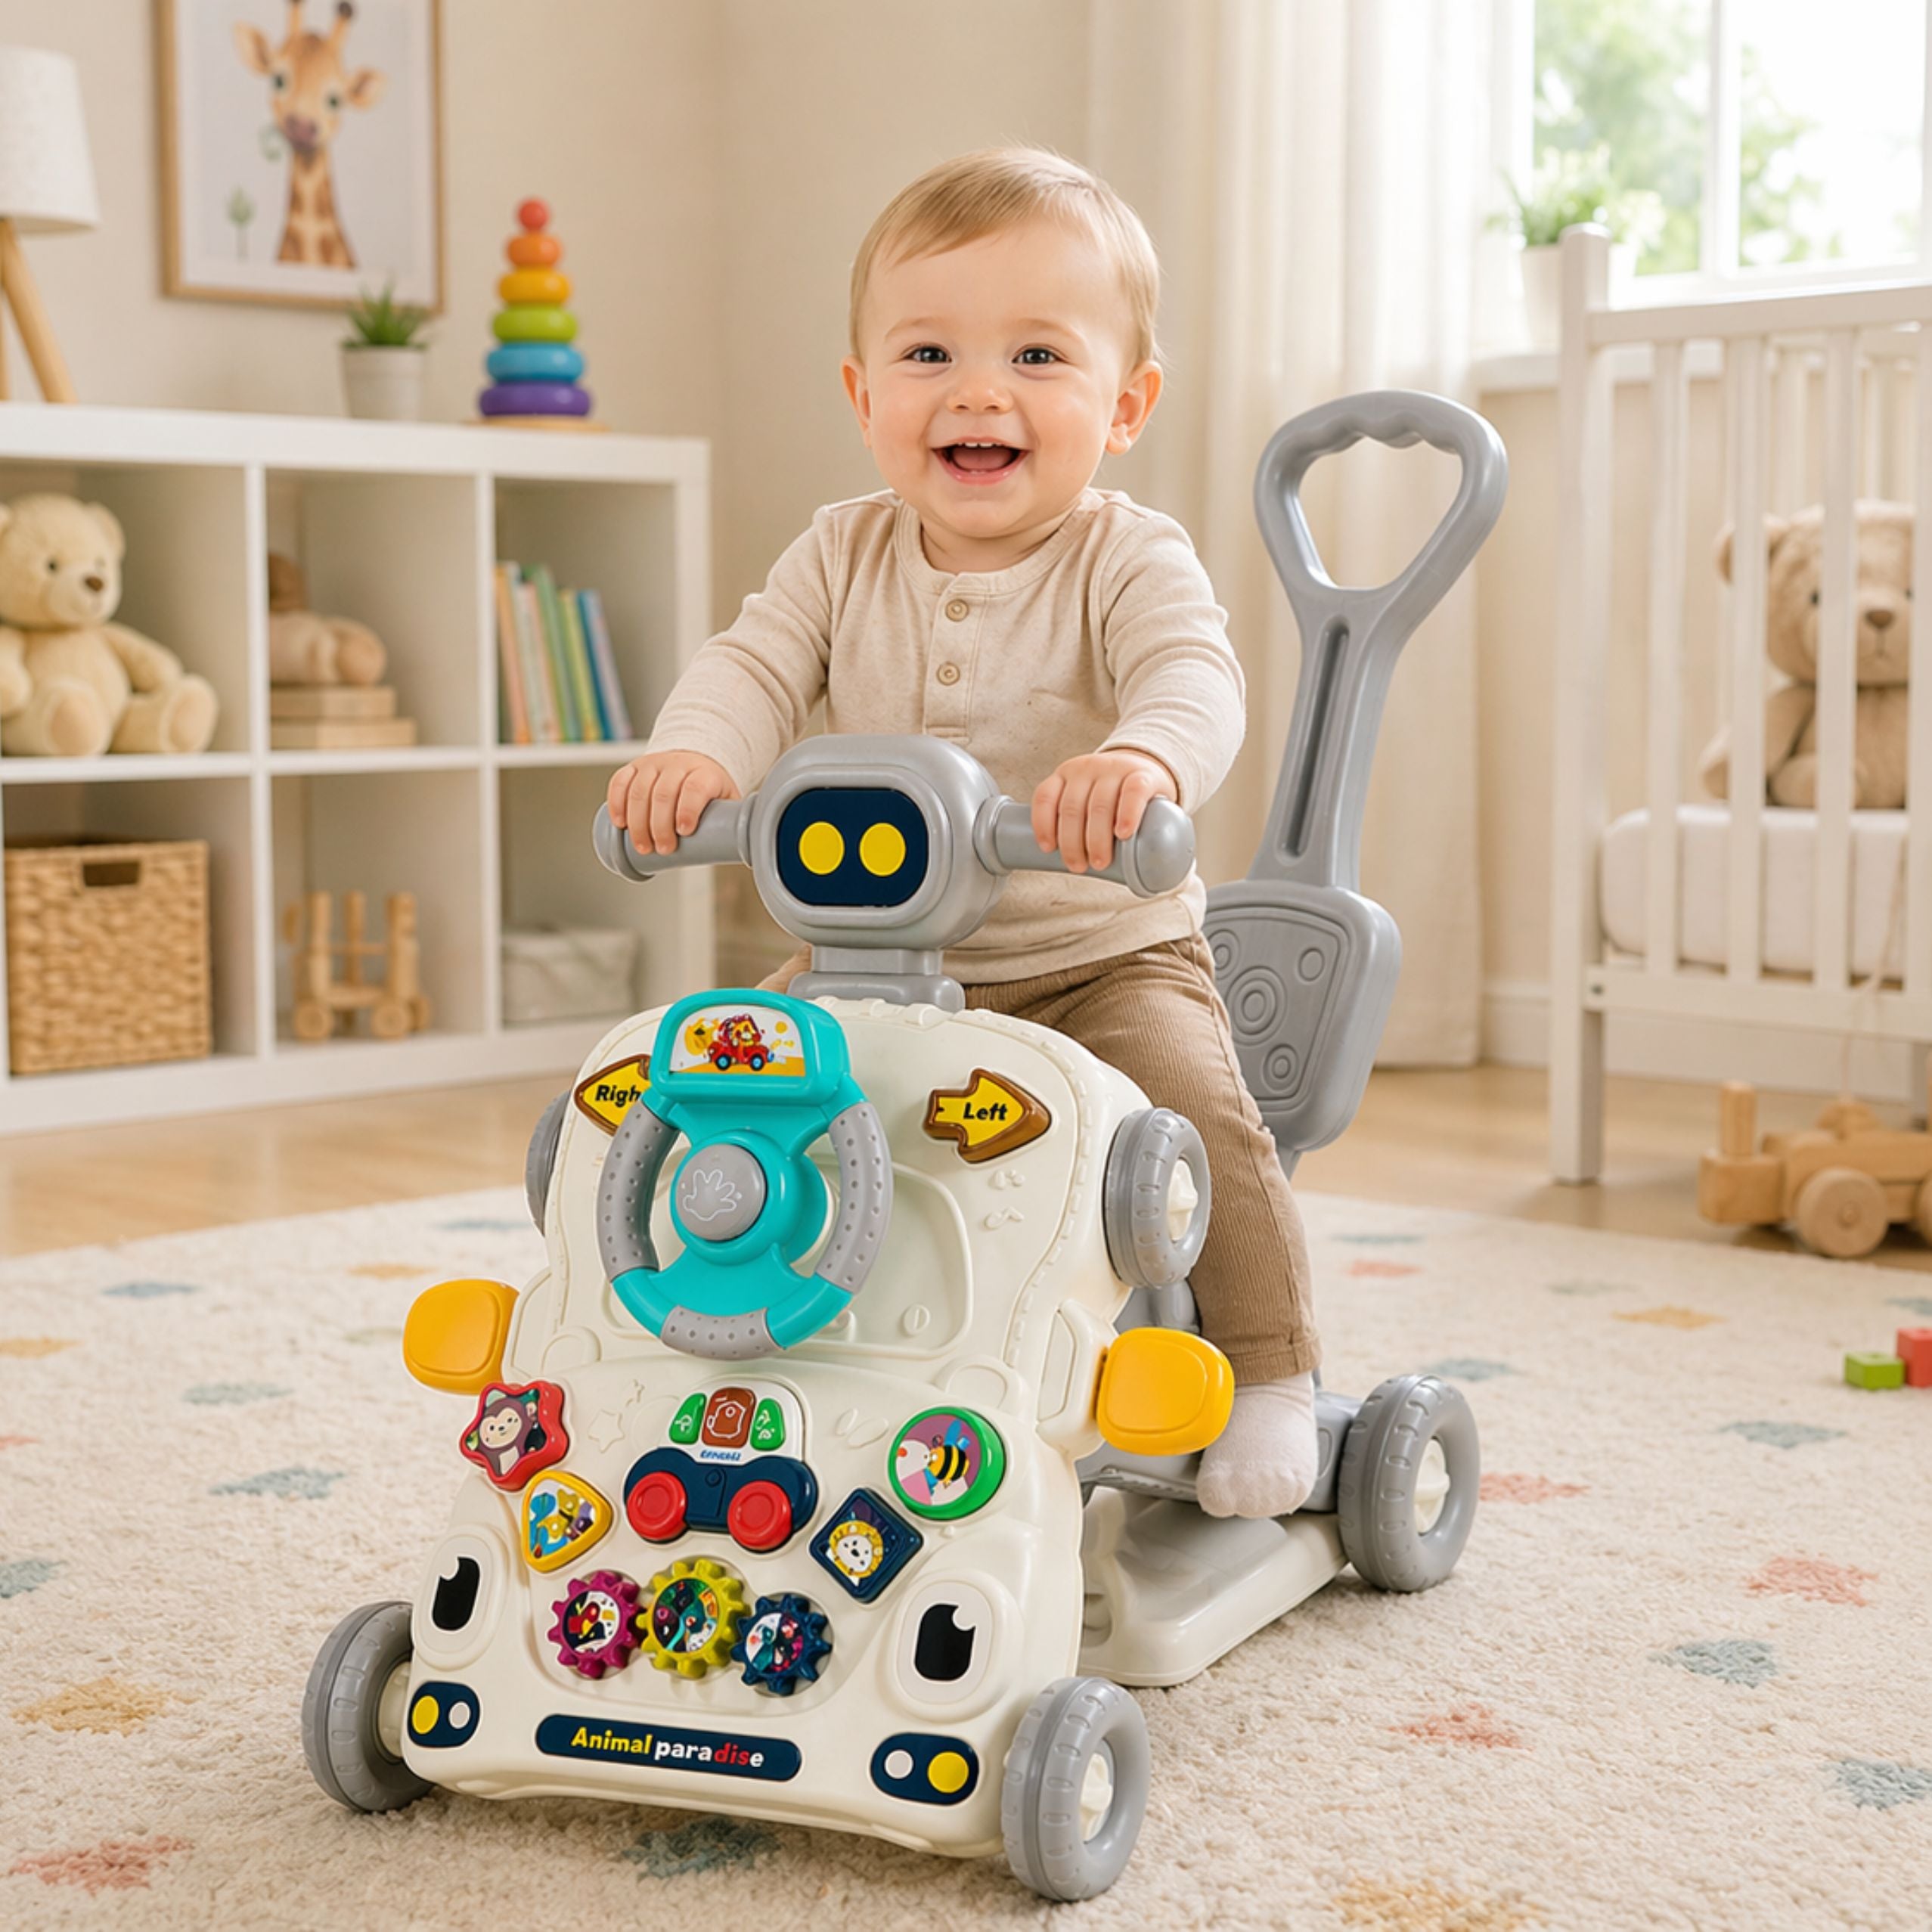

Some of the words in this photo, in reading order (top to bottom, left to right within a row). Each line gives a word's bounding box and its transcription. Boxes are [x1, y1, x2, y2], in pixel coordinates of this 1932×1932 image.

[595, 1084, 642, 1108] Righ
[963, 1102, 1008, 1121] Left
[570, 1726, 653, 1755] Animal
[653, 1741, 764, 1768] paradise
